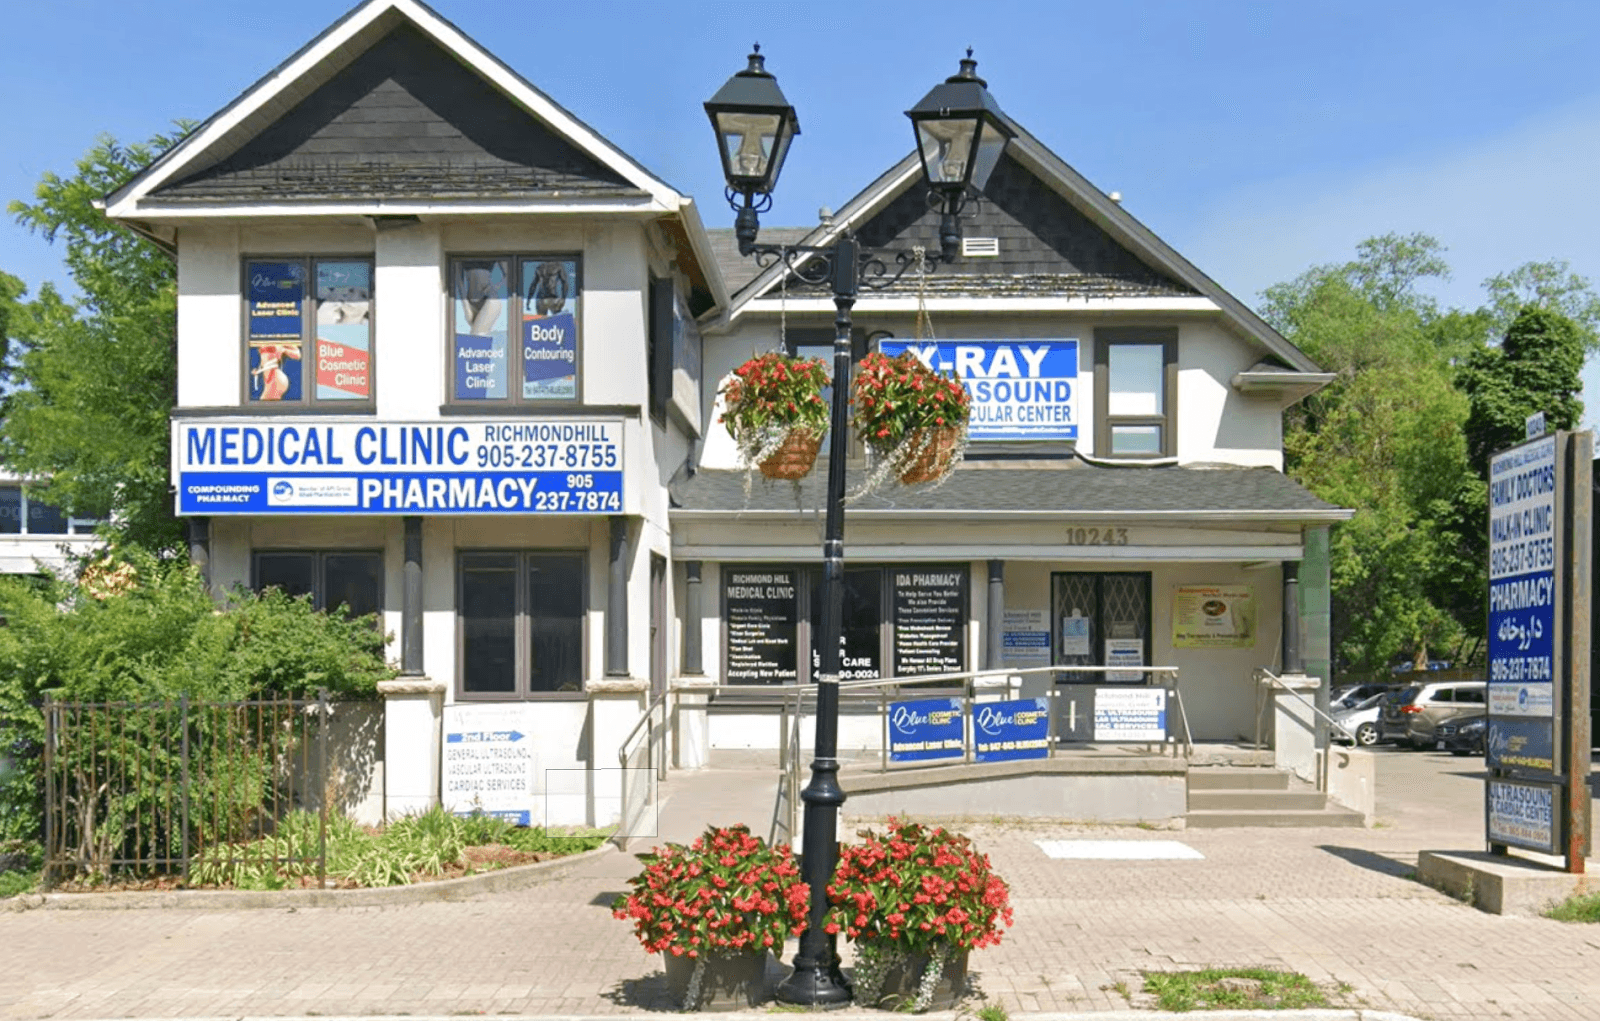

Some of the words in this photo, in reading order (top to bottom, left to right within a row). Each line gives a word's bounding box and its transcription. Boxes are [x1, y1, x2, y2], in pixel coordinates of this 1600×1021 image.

[531, 325, 564, 345] Body
[319, 345, 344, 357] Blue
[458, 347, 504, 358] Advanced
[524, 346, 574, 363] Contouring
[319, 359, 366, 371] Cosmetic
[465, 361, 495, 373] Laser
[906, 345, 1051, 378] X-RAY
[334, 373, 366, 386] Clinic
[465, 376, 495, 389] Clinic
[1017, 405, 1072, 423] CENTER
[484, 424, 610, 442] RICHMONDHILL
[186, 426, 344, 466] MEDICAL
[353, 425, 471, 466] CLINIC
[476, 444, 617, 468] 905-237-8755
[187, 485, 260, 494] COMPOUNDING
[566, 474, 594, 488] 905
[1517, 464, 1554, 500] DOCTORS
[197, 494, 250, 503] PHARMACY
[363, 477, 537, 509] PHARMACY
[535, 491, 620, 511] 237-7874
[1492, 511, 1521, 543] WALK-IN
[1522, 504, 1552, 536] CLINIC
[1066, 527, 1129, 546] 10243
[1491, 537, 1553, 575] 905-237-8755
[732, 574, 773, 584] RICHMOND
[773, 574, 790, 584] HILL
[896, 574, 911, 586] IDA
[912, 574, 961, 586] PHARMACY
[727, 587, 765, 599] MEDICAL
[766, 587, 795, 599] CLINIC
[1490, 576, 1554, 612] PHARMACY
[1498, 615, 1543, 651] داروخانه
[842, 657, 872, 667] CARE
[1491, 656, 1550, 680] 905-237-7874
[727, 670, 758, 679] Accepting
[774, 669, 796, 677] Patient
[892, 706, 928, 734] Blue
[977, 706, 1015, 735] Blue
[483, 730, 511, 742] Floor
[484, 762, 526, 774] ULTRASOUND
[448, 780, 484, 791] CARDIAC
[486, 779, 526, 790] SERVICES
[1490, 784, 1553, 806] ULTRASOUND
